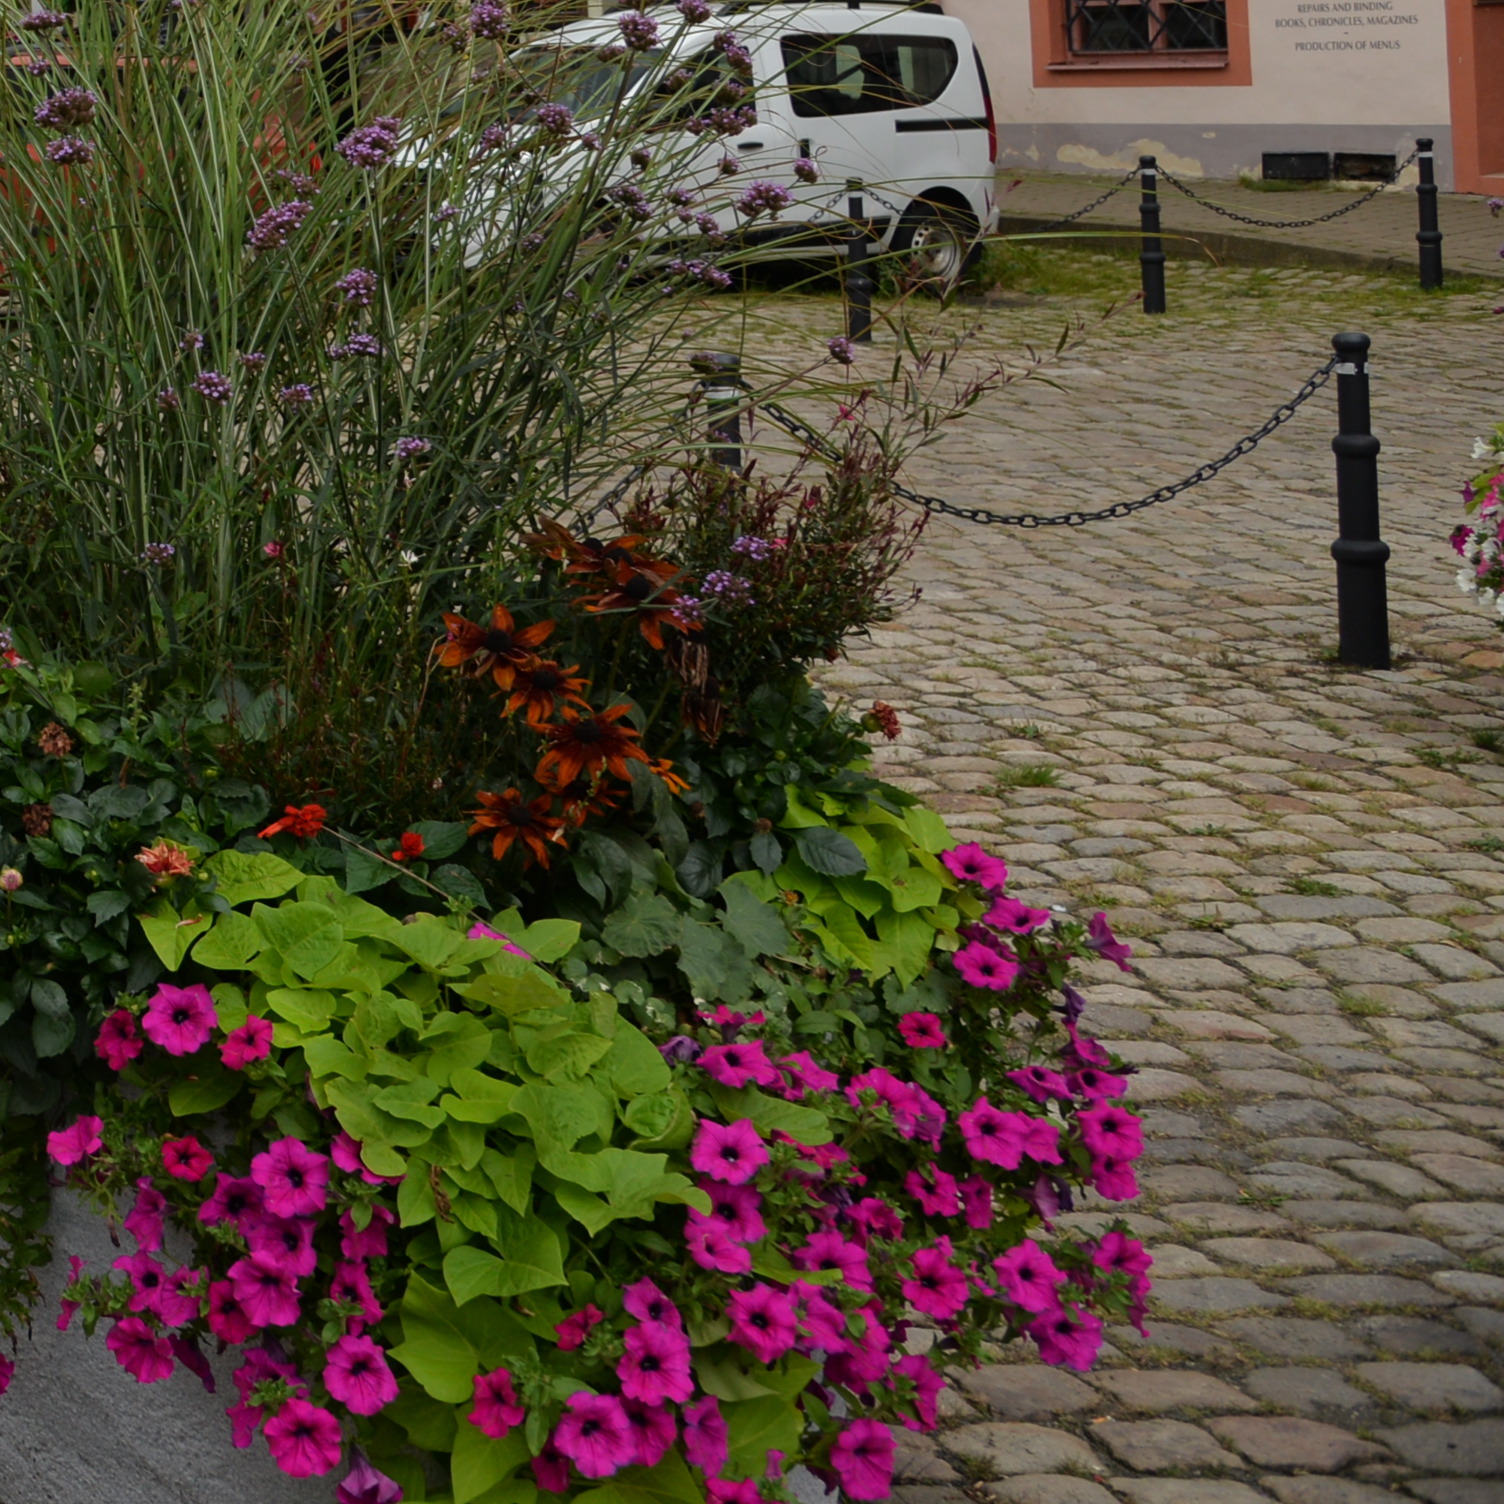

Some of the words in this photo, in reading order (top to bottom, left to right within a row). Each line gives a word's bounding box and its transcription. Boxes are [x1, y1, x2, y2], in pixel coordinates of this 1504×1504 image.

[1297, 3, 1330, 13] REPAIRS
[1332, 2, 1352, 12] AND
[1353, 1, 1393, 11] BINDING
[1275, 18, 1307, 28] BOOKS,
[1308, 16, 1365, 27] CHRONICLES,
[1367, 15, 1419, 25] MAGAZINES
[1295, 41, 1353, 51] PRODUCTION
[1355, 40, 1367, 50] OF
[1369, 40, 1401, 50] MENUS
